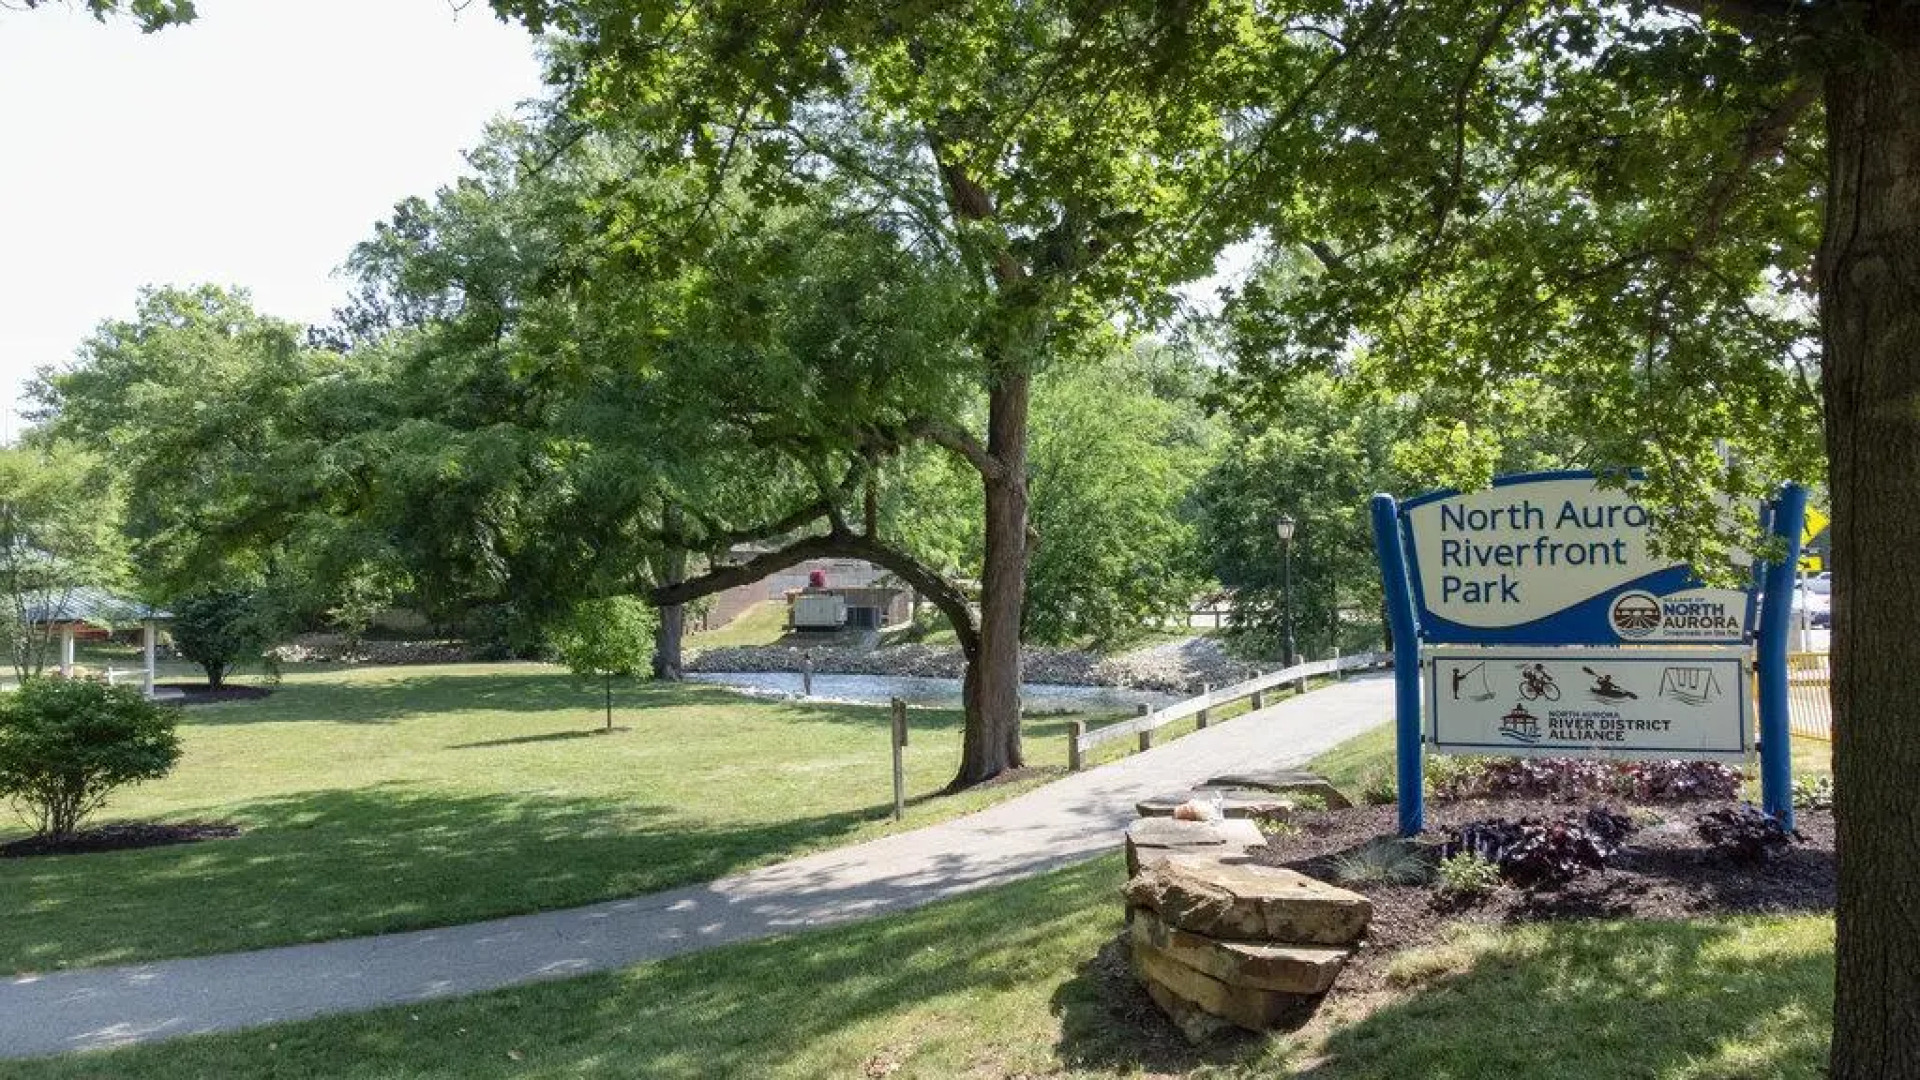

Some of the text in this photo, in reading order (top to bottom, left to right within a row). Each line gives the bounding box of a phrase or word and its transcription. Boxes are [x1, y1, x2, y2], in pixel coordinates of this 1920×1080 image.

[1441, 500, 1656, 531] North Auro
[1441, 537, 1626, 567] Riverfront
[1442, 575, 1520, 603] Park
[1662, 603, 1724, 616] NORTH
[1662, 616, 1739, 629] AURORA
[1548, 718, 1672, 732] RIVER DISTRICT
[1548, 730, 1624, 741] ALLIANCE
